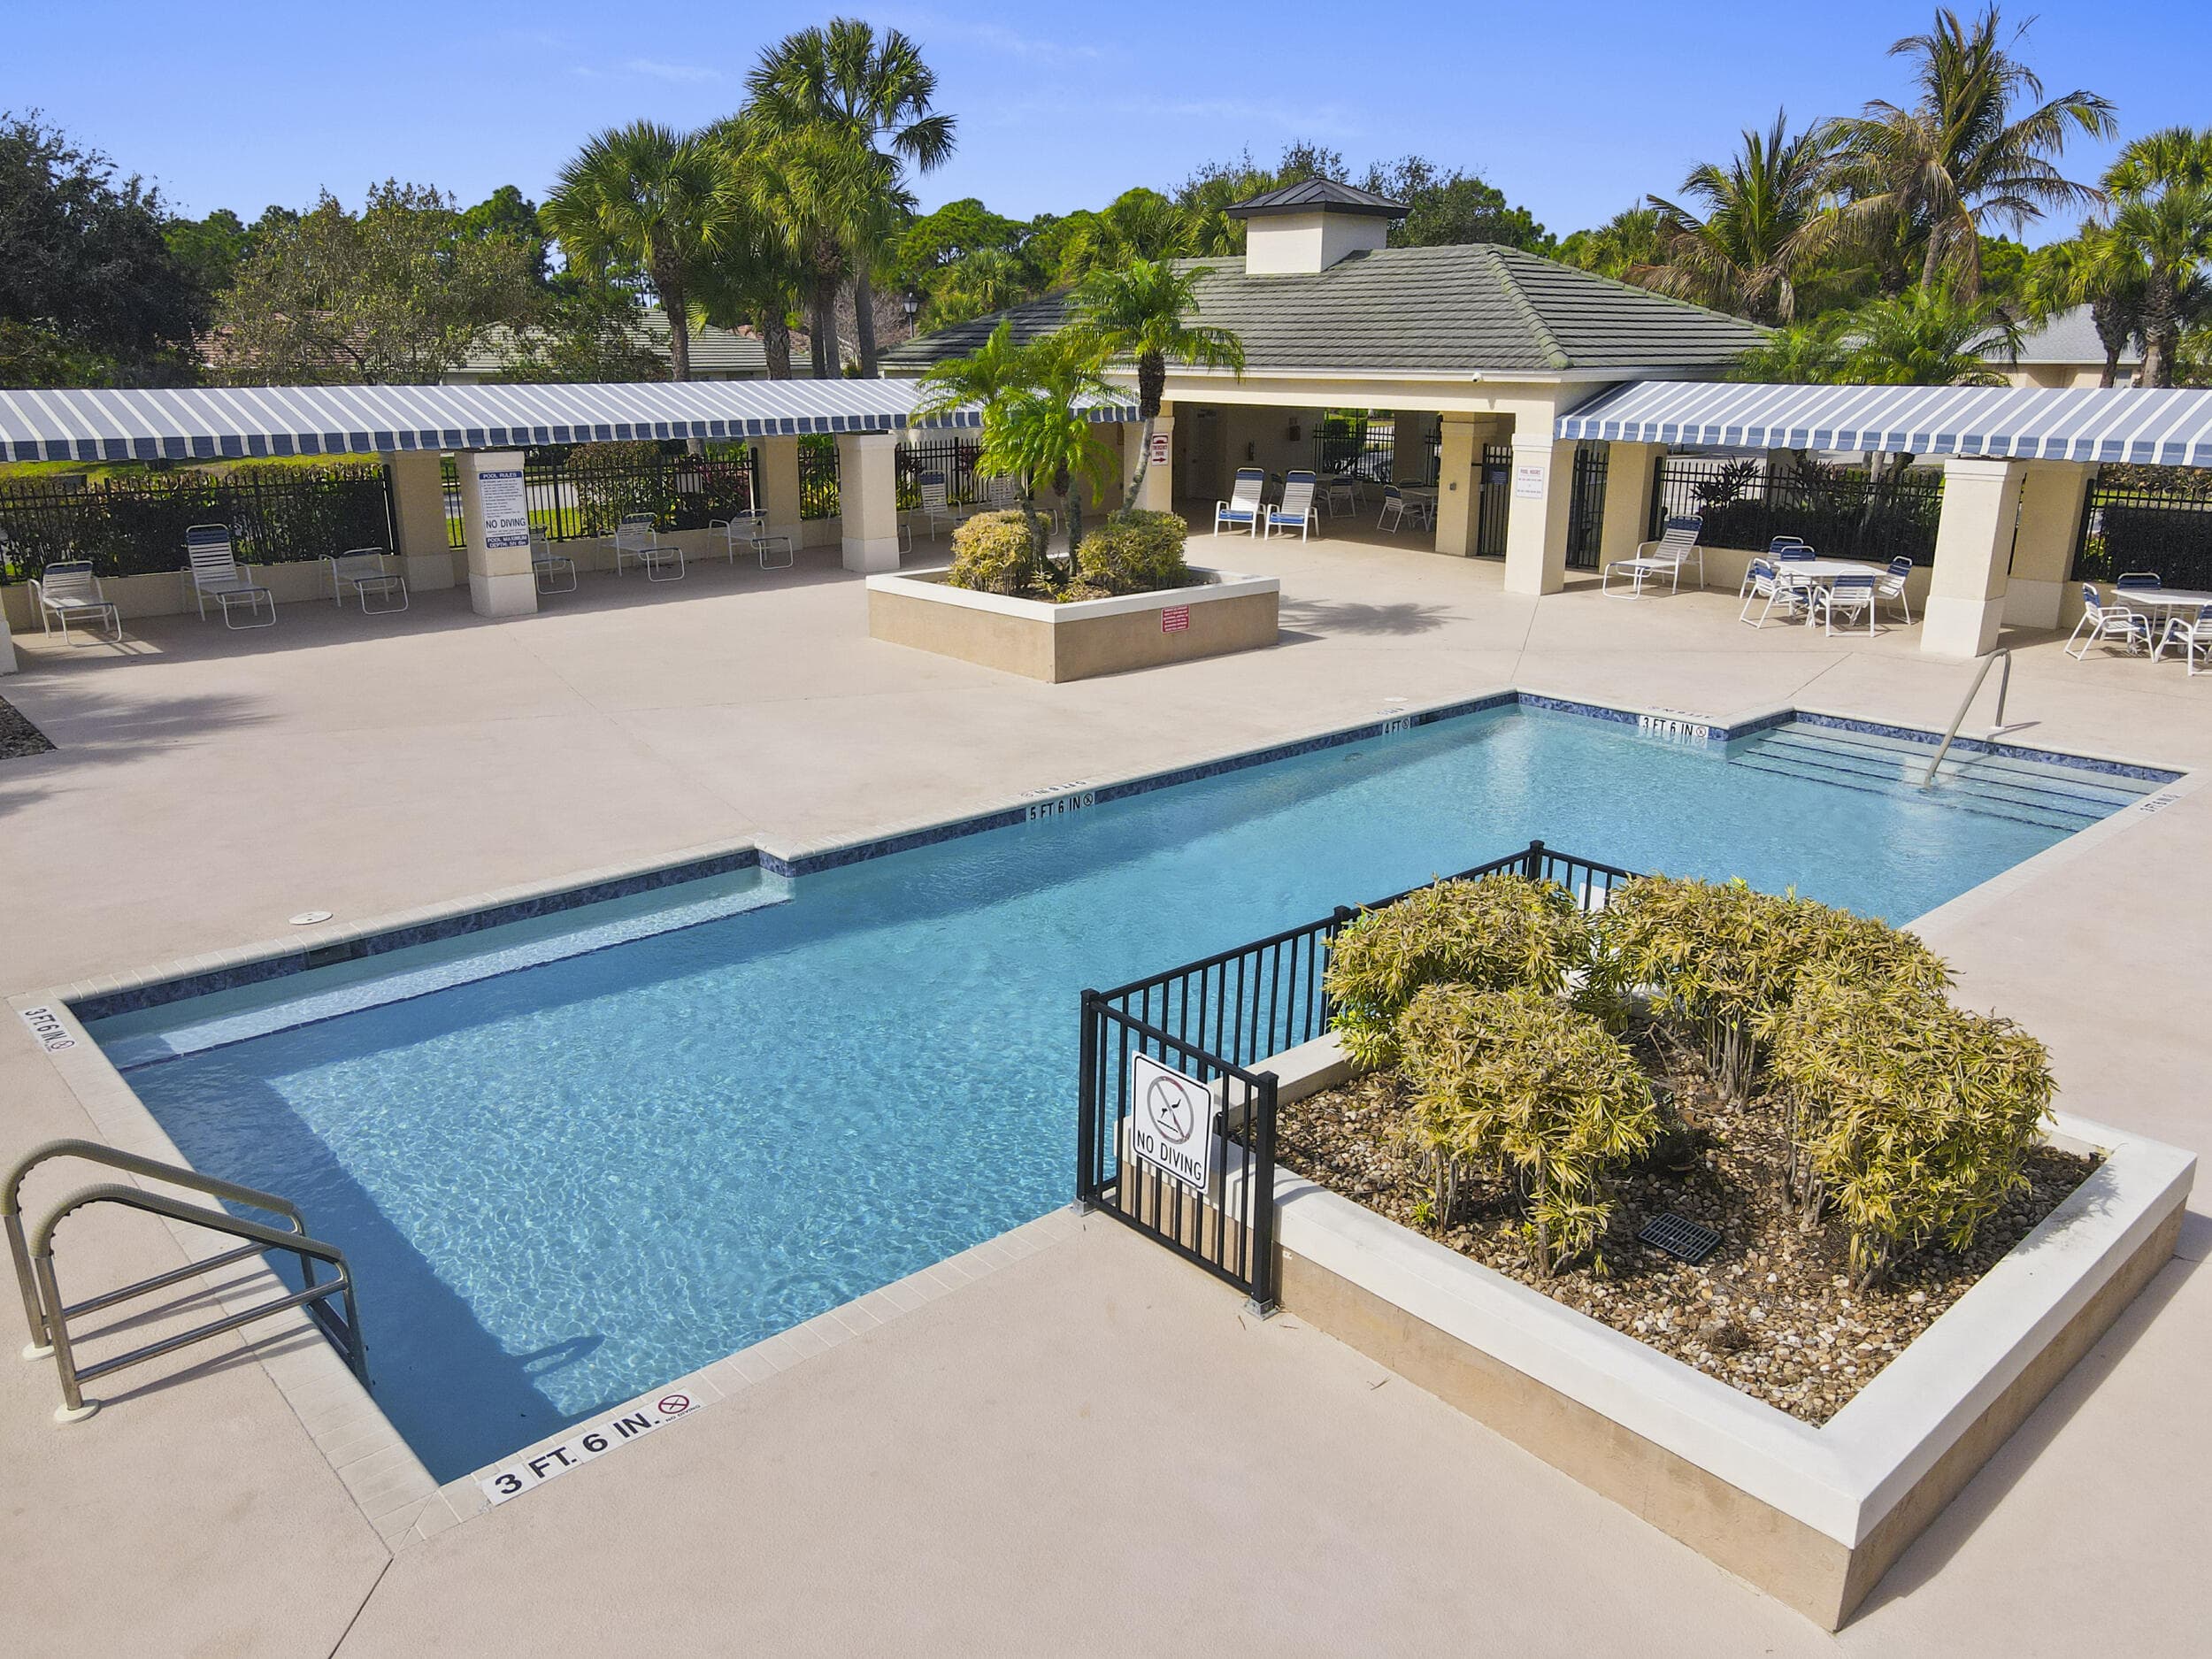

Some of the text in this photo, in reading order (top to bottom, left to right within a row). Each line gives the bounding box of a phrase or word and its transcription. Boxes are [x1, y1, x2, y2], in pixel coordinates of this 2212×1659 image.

[486, 518, 526, 529] NO DIVING
[1385, 720, 1401, 733] 4 FT
[1643, 717, 1694, 736] 3 FT 6 IN
[1030, 795, 1080, 820] 5 FT 6 IN
[1137, 1129, 1202, 1180] NO DIVING
[677, 1404, 701, 1417] DIVING
[495, 1413, 660, 1494] 3 FT. 6 IN.
